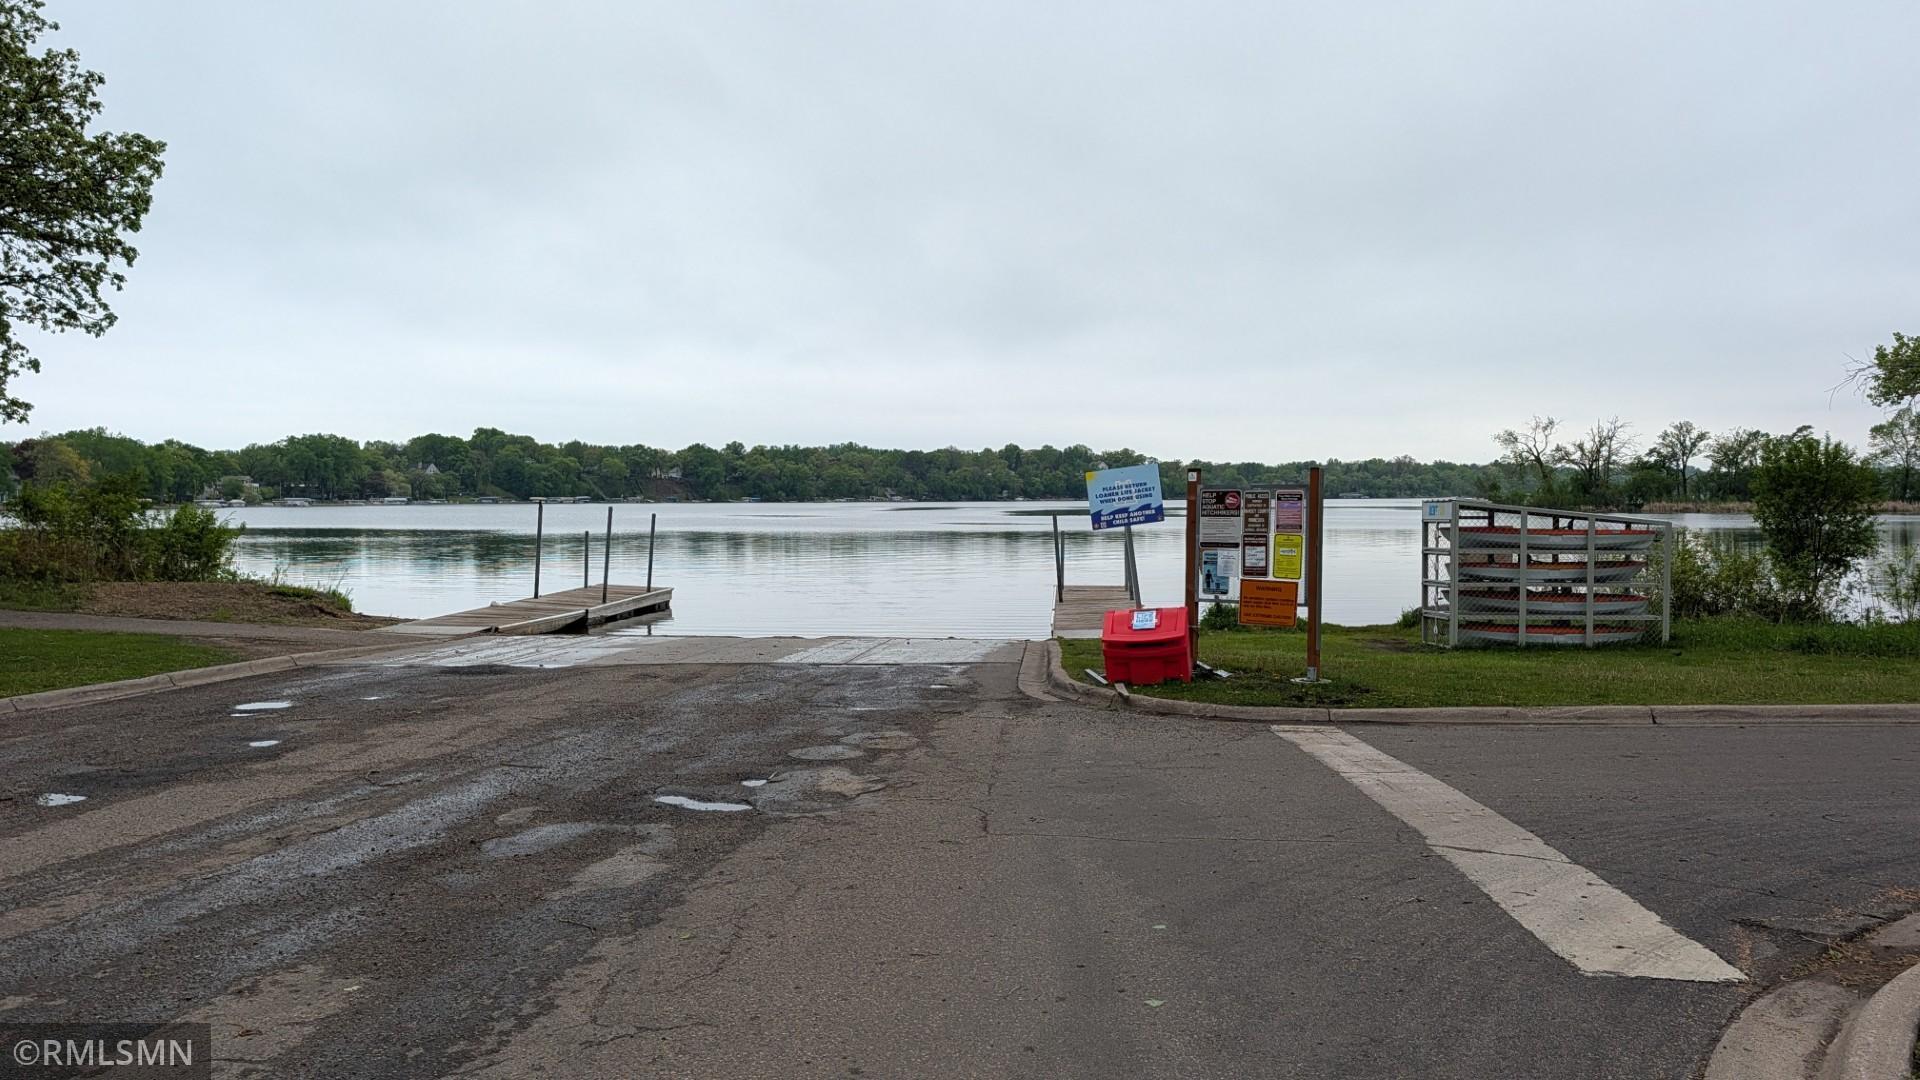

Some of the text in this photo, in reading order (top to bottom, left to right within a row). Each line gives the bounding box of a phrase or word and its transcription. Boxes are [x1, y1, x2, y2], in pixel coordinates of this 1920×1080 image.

[1095, 491, 1119, 499] LOANER
[1134, 486, 1155, 494] JACKET
[1103, 484, 1123, 492] PLEASE
[1129, 509, 1156, 518] ANOTHER
